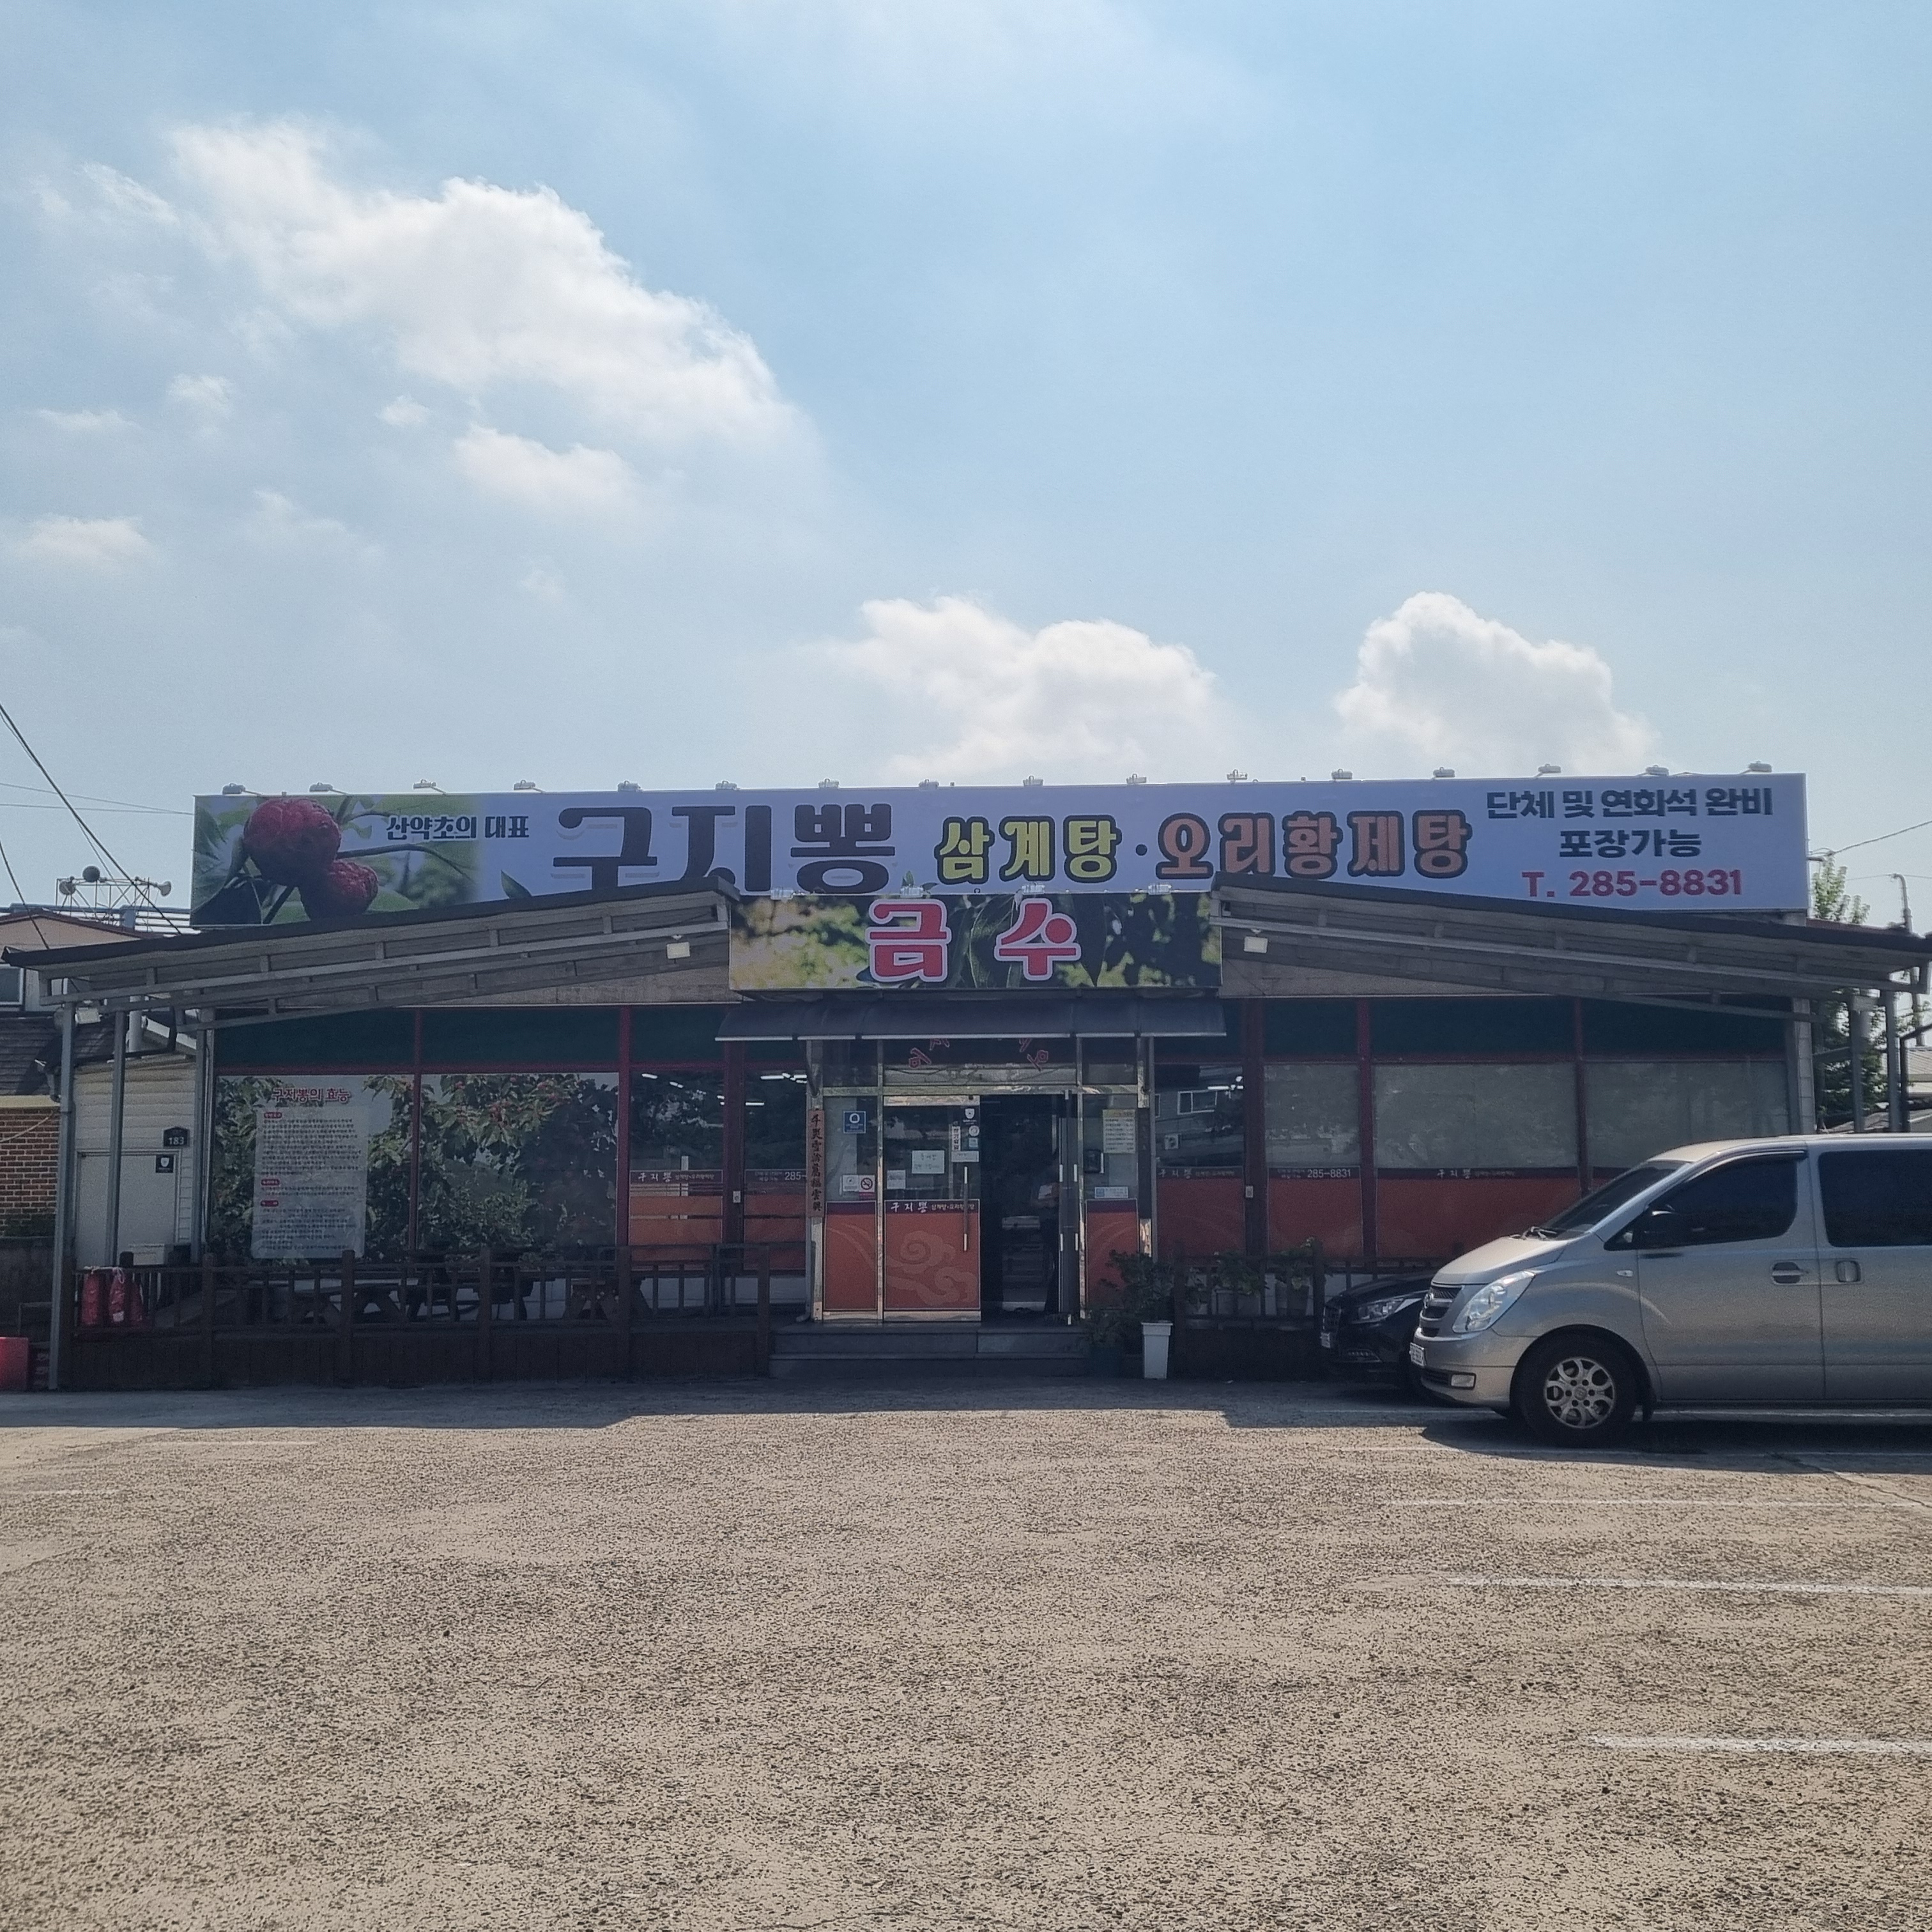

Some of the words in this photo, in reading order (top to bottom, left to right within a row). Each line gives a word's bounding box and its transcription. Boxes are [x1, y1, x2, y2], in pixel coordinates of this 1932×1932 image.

[1486, 790, 1555, 819] 단체
[1562, 790, 1595, 819] 및
[1600, 788, 1698, 818] 연회석
[1705, 787, 1774, 816] 완비
[386, 815, 478, 841] 산약초의
[484, 815, 530, 839] 대표
[1559, 828, 1703, 858] 포장가능
[1568, 869, 1742, 897] 285-8831
[325, 1087, 351, 1103] 효능
[169, 1137, 185, 1145] 183
[1307, 1168, 1351, 1178] 285-8831
